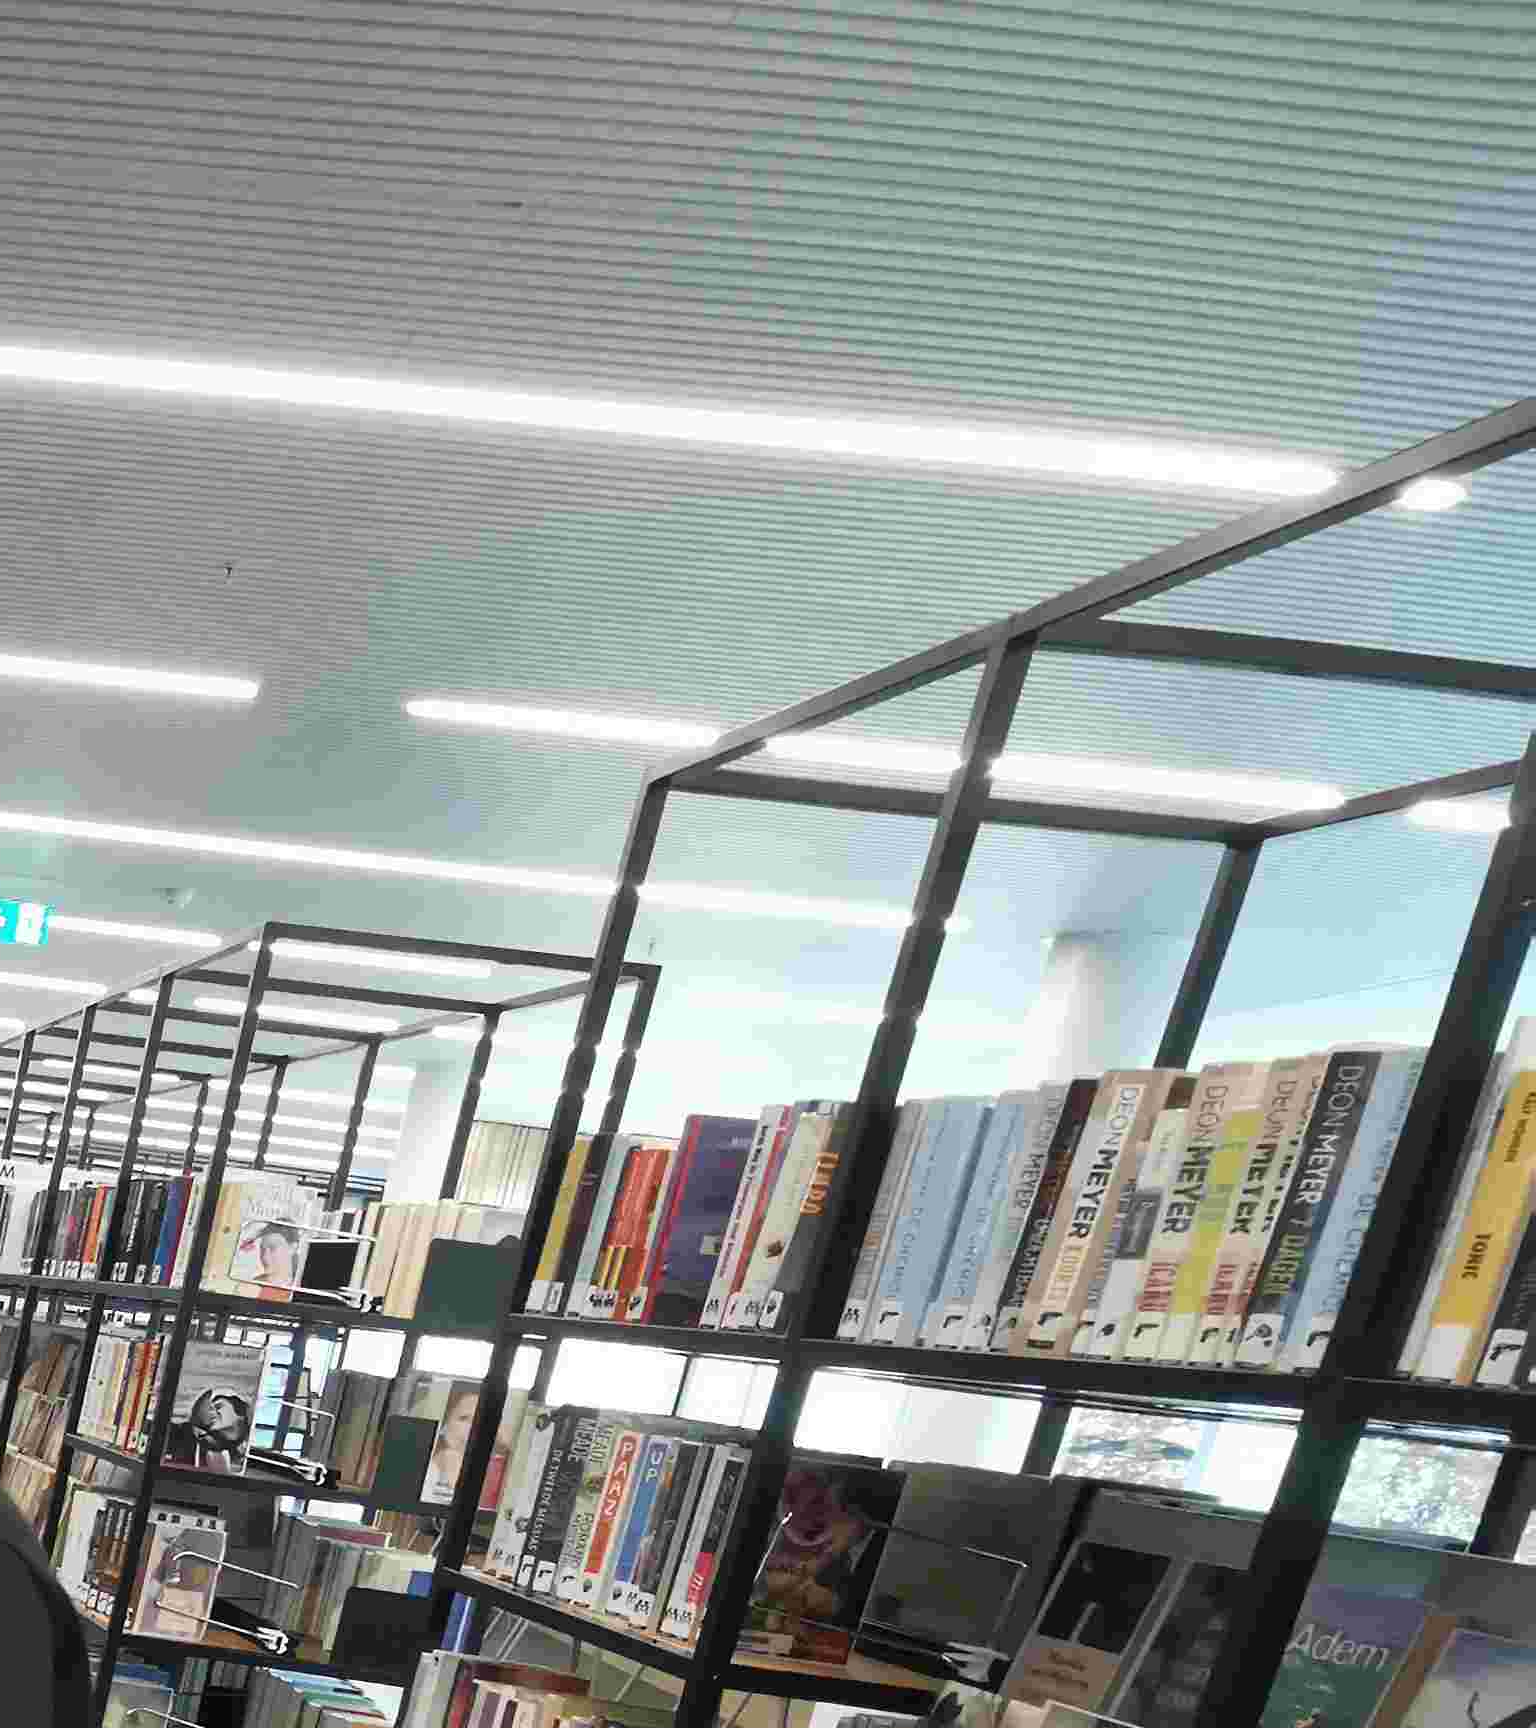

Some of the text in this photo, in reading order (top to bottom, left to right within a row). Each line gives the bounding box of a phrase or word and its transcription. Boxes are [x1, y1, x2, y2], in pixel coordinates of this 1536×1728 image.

[1103, 1086, 1139, 1147] DEON
[1198, 1085, 1228, 1143] DEON
[1321, 1063, 1365, 1128] DEON
[1067, 1148, 1119, 1239] MEYER
[1162, 1142, 1215, 1234] MEYER
[1230, 1142, 1279, 1235] MEYER
[1294, 1132, 1339, 1206] MEYER
[603, 1439, 634, 1519] PAAZ
[645, 1451, 664, 1482] UP
[1286, 1623, 1391, 1674] Adem
